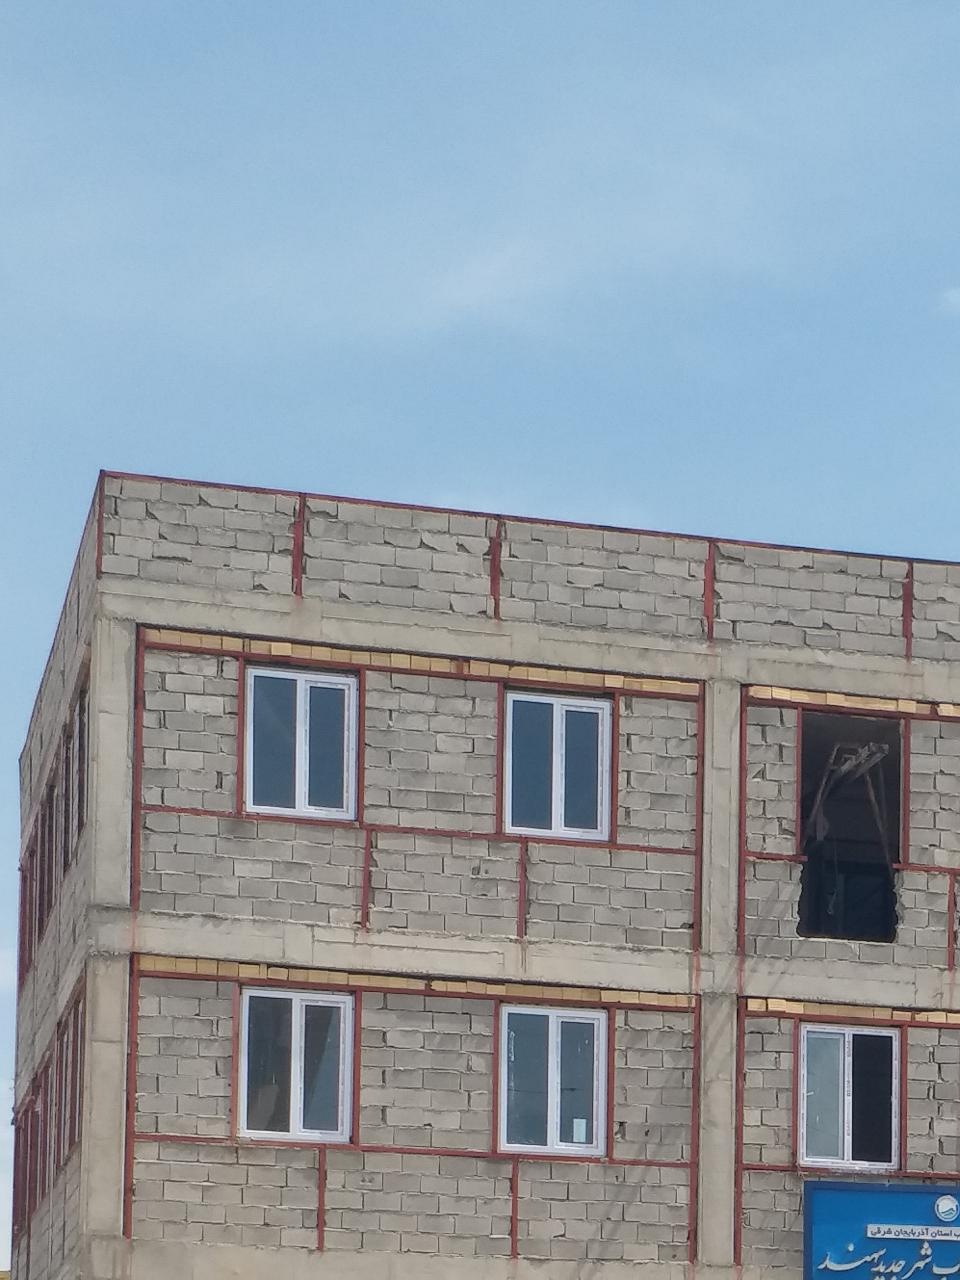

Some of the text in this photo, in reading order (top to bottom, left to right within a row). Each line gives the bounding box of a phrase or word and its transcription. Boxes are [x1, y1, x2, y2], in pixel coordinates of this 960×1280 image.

[870, 1226, 893, 1236] شرقی
[894, 1227, 929, 1238] آذربایجان
[930, 1229, 953, 1238] استان
[817, 1243, 887, 1273] سهند
[901, 1241, 933, 1280] شهر
